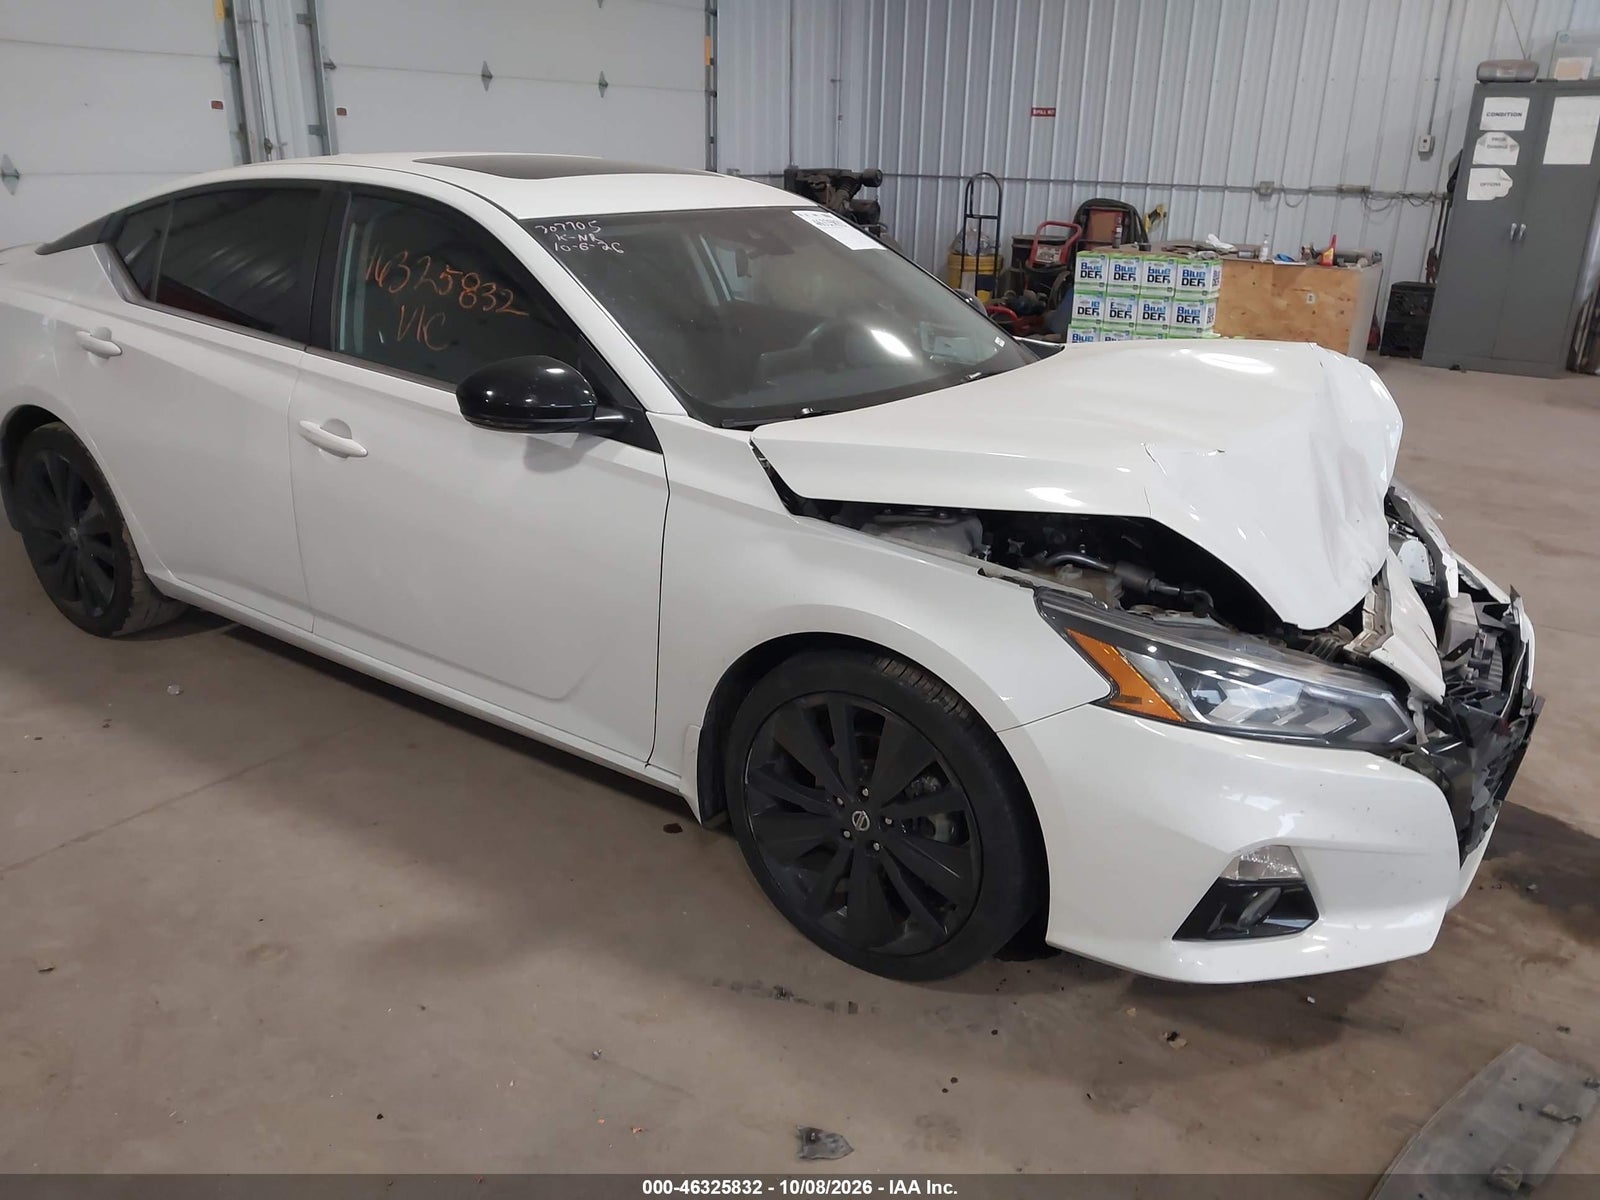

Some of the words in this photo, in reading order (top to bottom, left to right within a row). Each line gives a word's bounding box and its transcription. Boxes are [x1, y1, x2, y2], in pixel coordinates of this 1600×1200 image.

[1080, 270, 1102, 279] DEF
[1113, 272, 1136, 282] DEF
[1147, 274, 1171, 284] DEF
[1181, 278, 1206, 287] DEF
[1077, 306, 1100, 316] DEF
[1109, 309, 1133, 319] DEF
[1142, 312, 1166, 321] DEF
[1176, 315, 1201, 324] DEF
